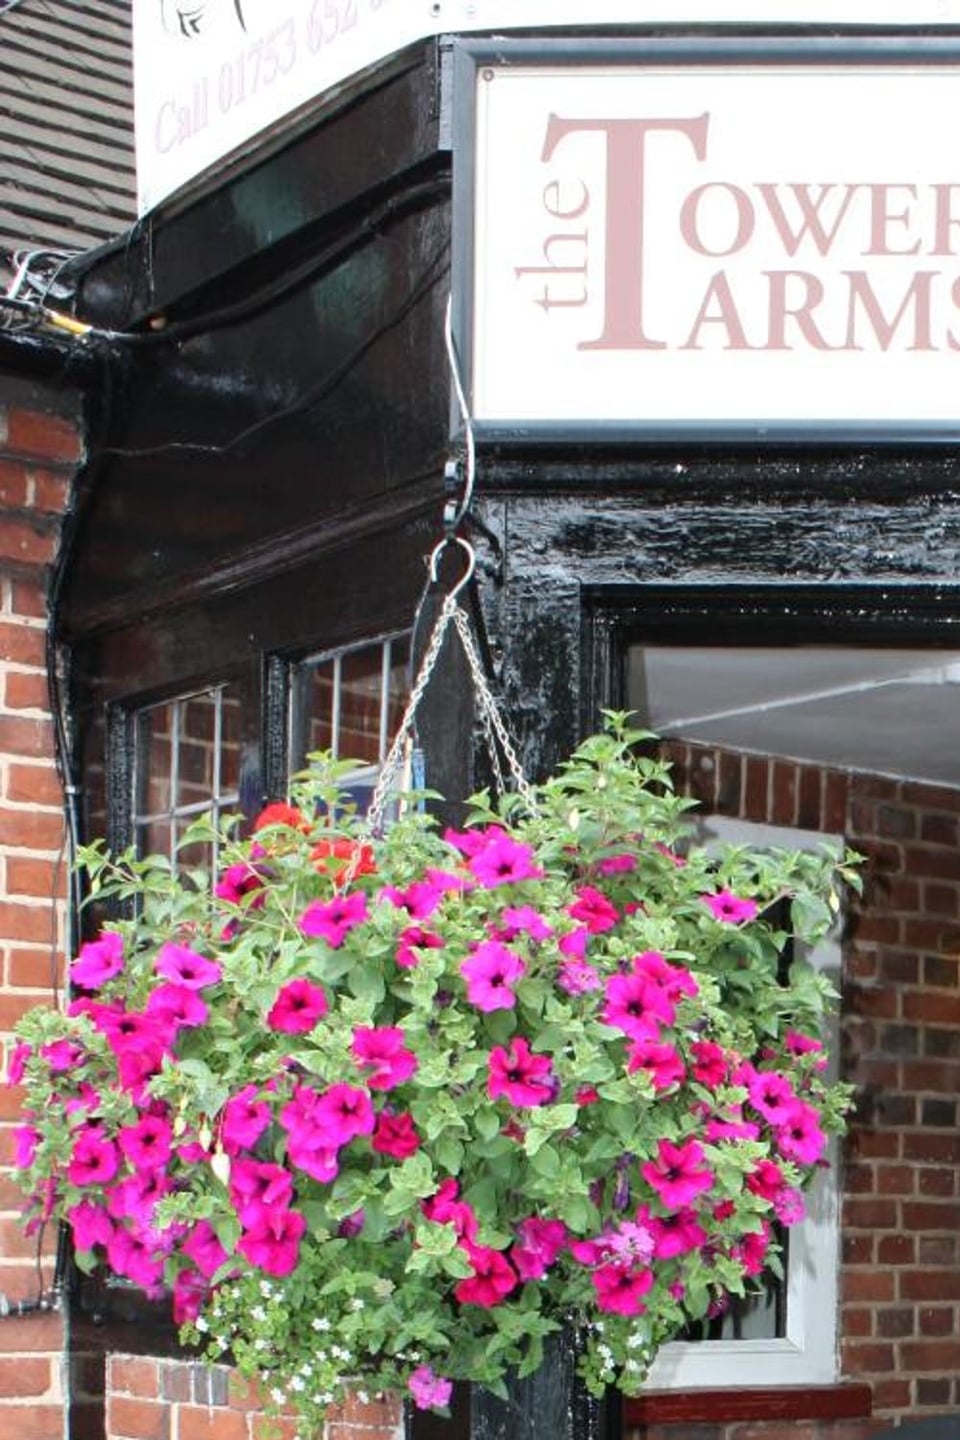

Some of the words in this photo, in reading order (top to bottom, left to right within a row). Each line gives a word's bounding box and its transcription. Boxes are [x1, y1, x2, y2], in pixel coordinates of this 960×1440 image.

[154, 77, 209, 154] Call
[217, 16, 297, 115] 01753
[514, 178, 589, 313] the
